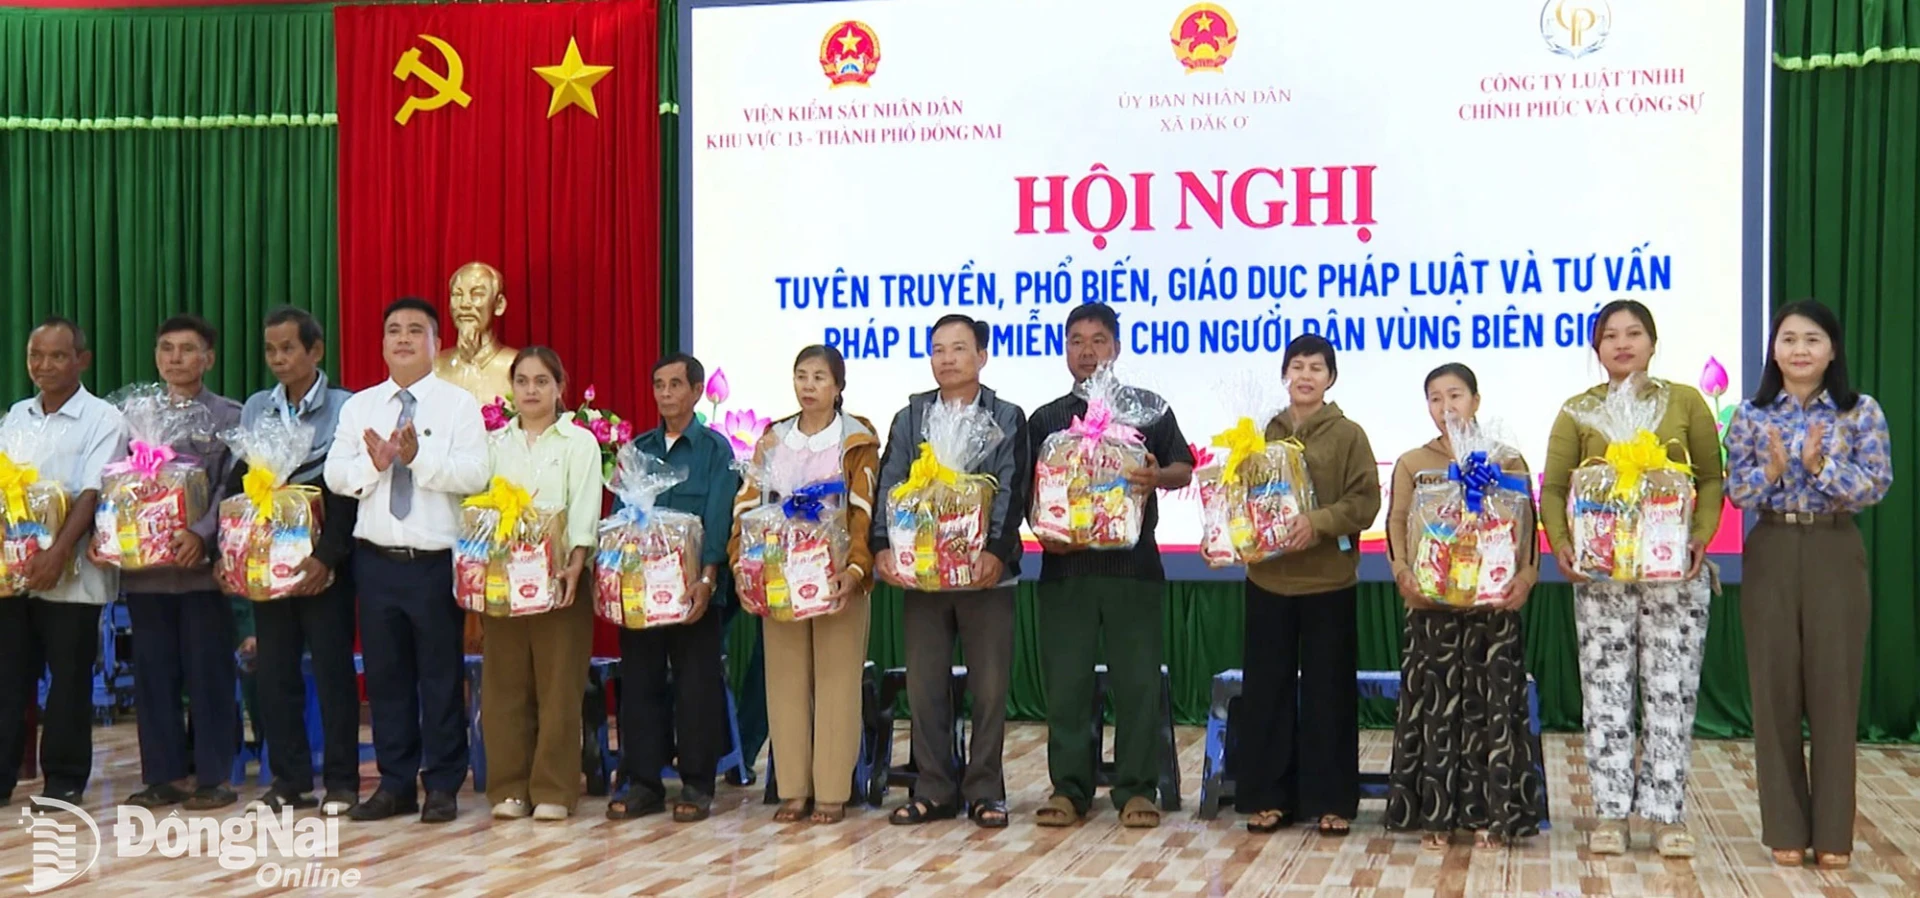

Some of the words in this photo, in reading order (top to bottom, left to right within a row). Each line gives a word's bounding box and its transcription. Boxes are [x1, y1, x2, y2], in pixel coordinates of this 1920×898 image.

[1480, 73, 1535, 93] CÔNG
[1540, 74, 1566, 90] TY
[1571, 67, 1623, 92] LUẬT
[1626, 68, 1684, 86] TNHH
[743, 103, 783, 126] VIỆN
[837, 98, 869, 120] SÁT
[873, 97, 922, 118] NHÂN
[926, 95, 963, 116] DÂN
[1149, 93, 1186, 108] BAN
[1192, 86, 1246, 107] NHÂN
[1252, 85, 1291, 104] DÂN
[1459, 98, 1521, 120] CHÍNH
[1584, 93, 1609, 114] VÀ
[707, 133, 742, 149] KHU
[788, 131, 803, 147] 13
[972, 123, 1002, 140] NAI
[1014, 162, 1155, 250] HỘI
[1174, 165, 1378, 243] NGHỊ
[775, 266, 869, 310] TUYÊN
[879, 259, 1004, 310] TRUYỀN,
[1015, 255, 1073, 305] PHỔ
[1081, 255, 1158, 307] BIẾN,
[1168, 257, 1238, 301] GIÁO
[1248, 264, 1308, 309] DỤC
[1318, 253, 1400, 298] PHÁP
[1410, 251, 1489, 306] LUẬT
[1500, 249, 1542, 294] VÀ
[1552, 253, 1597, 293] TƯ
[1603, 241, 1671, 292] VẤN
[824, 317, 899, 359] PHÁP
[992, 309, 1063, 357] MIỄN
[1131, 320, 1189, 355] CHO
[1200, 309, 1291, 353] NGƯỜI
[1376, 306, 1460, 351] VÙNG
[1472, 304, 1543, 349] BIÊN
